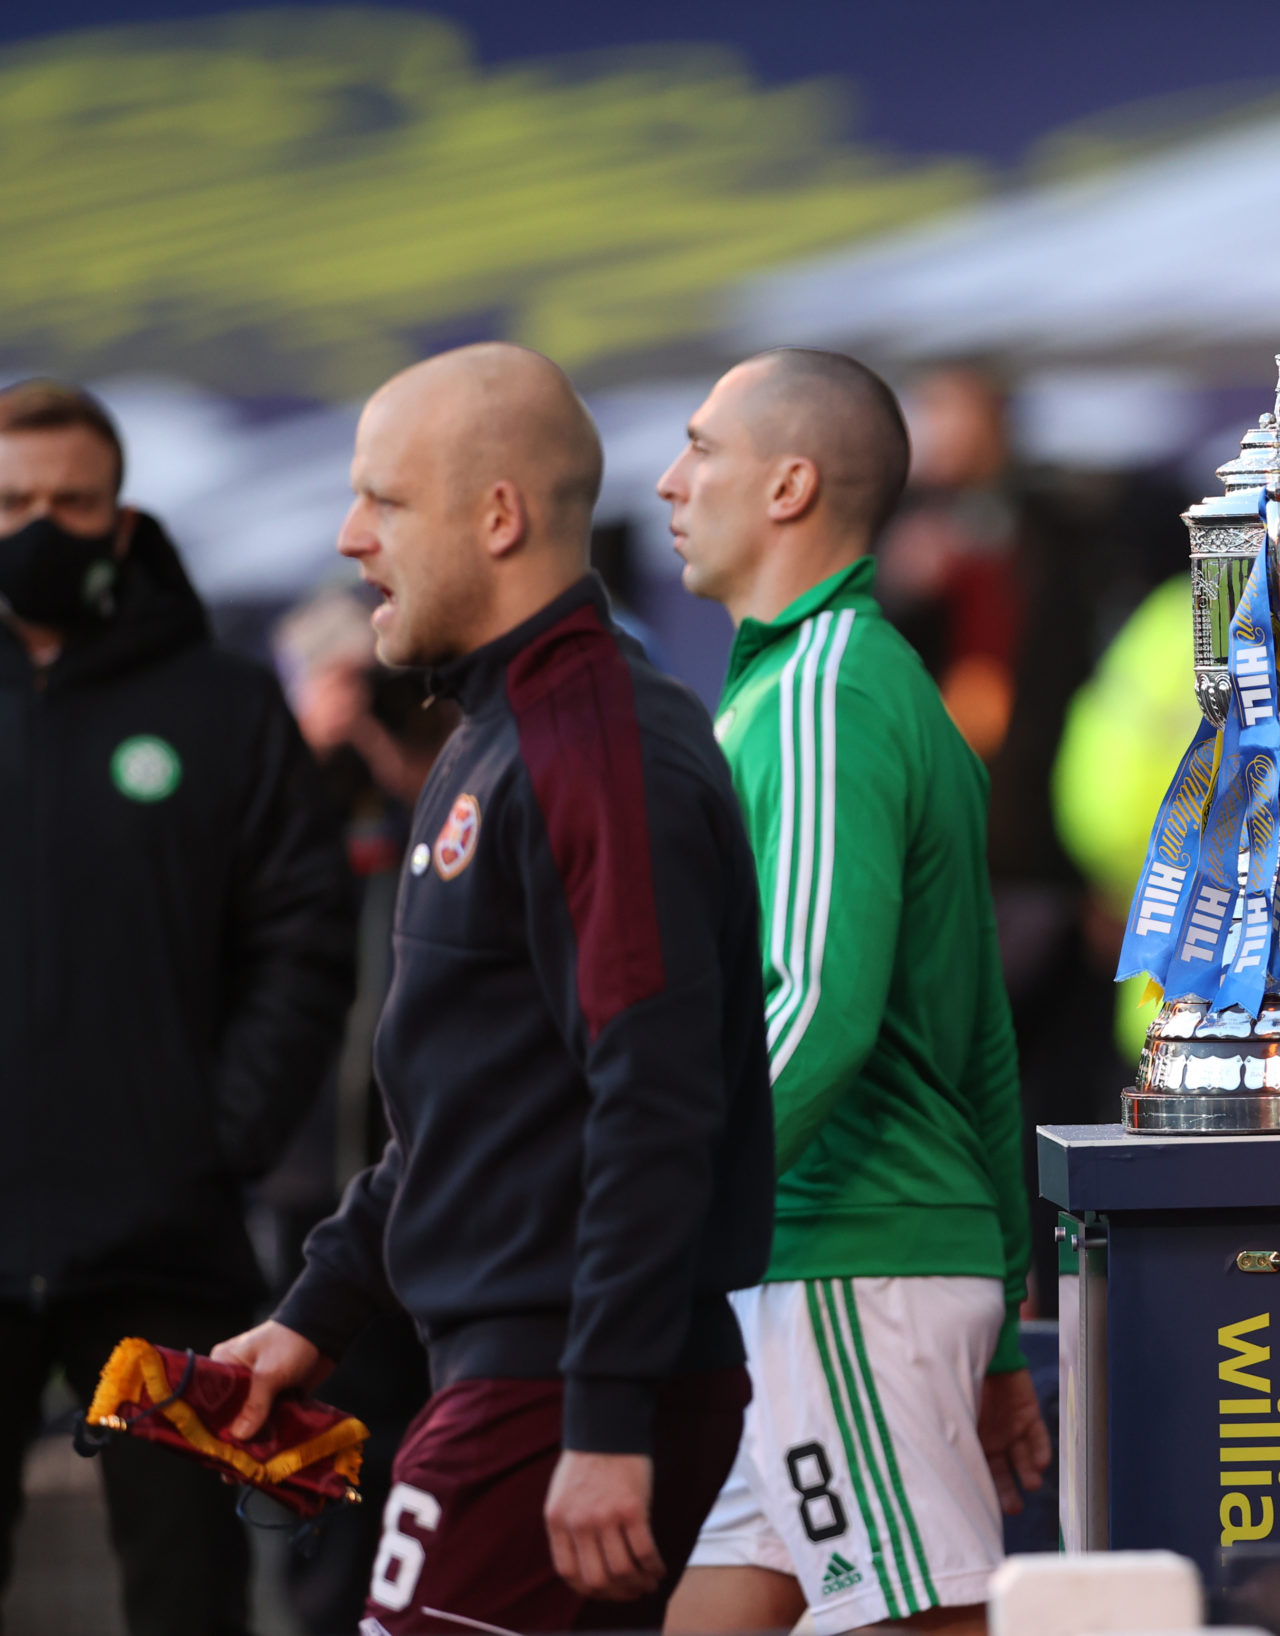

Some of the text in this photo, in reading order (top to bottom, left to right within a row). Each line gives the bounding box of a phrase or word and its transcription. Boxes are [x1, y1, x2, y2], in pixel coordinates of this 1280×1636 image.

[1236, 645, 1274, 726] HILL
[1135, 737, 1217, 937] William HILL
[1233, 754, 1276, 974] William HILL
[1180, 885, 1232, 963] HILL
[785, 1441, 848, 1543] 8
[369, 1480, 442, 1613] 6
[821, 1571, 863, 1596] adidas
